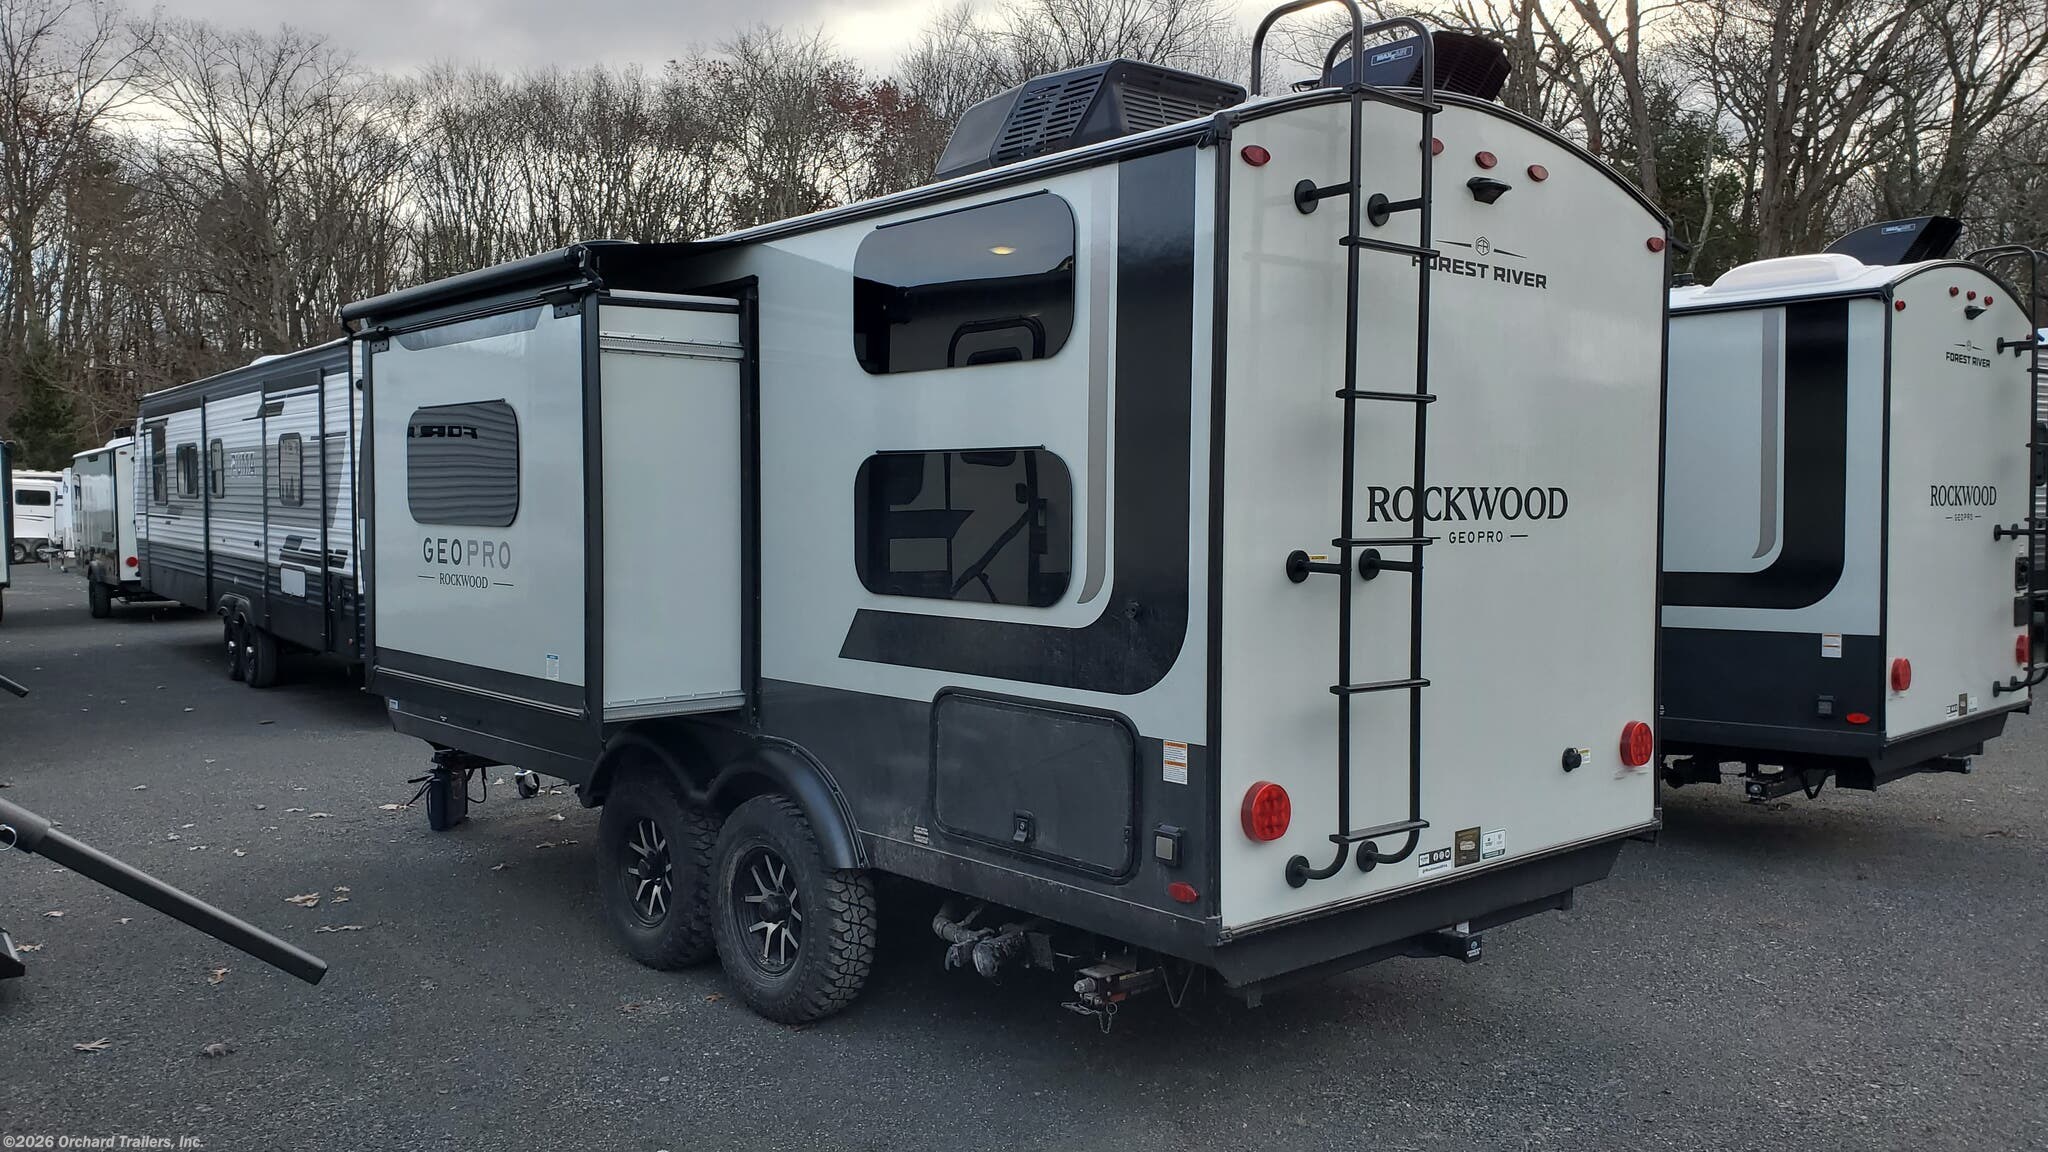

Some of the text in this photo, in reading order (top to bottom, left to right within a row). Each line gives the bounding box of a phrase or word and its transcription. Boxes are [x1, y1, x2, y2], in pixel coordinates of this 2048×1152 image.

[1493, 265, 1547, 289] RIVER
[1946, 351, 1991, 368] FOREST RIVER
[1366, 486, 1568, 522] ROCKWOOD
[1930, 485, 1997, 506] ROCKWOOD
[1448, 531, 1503, 543] GEOPRO
[423, 537, 511, 569] GEOPRO
[439, 573, 488, 588] ROCKWOOD
